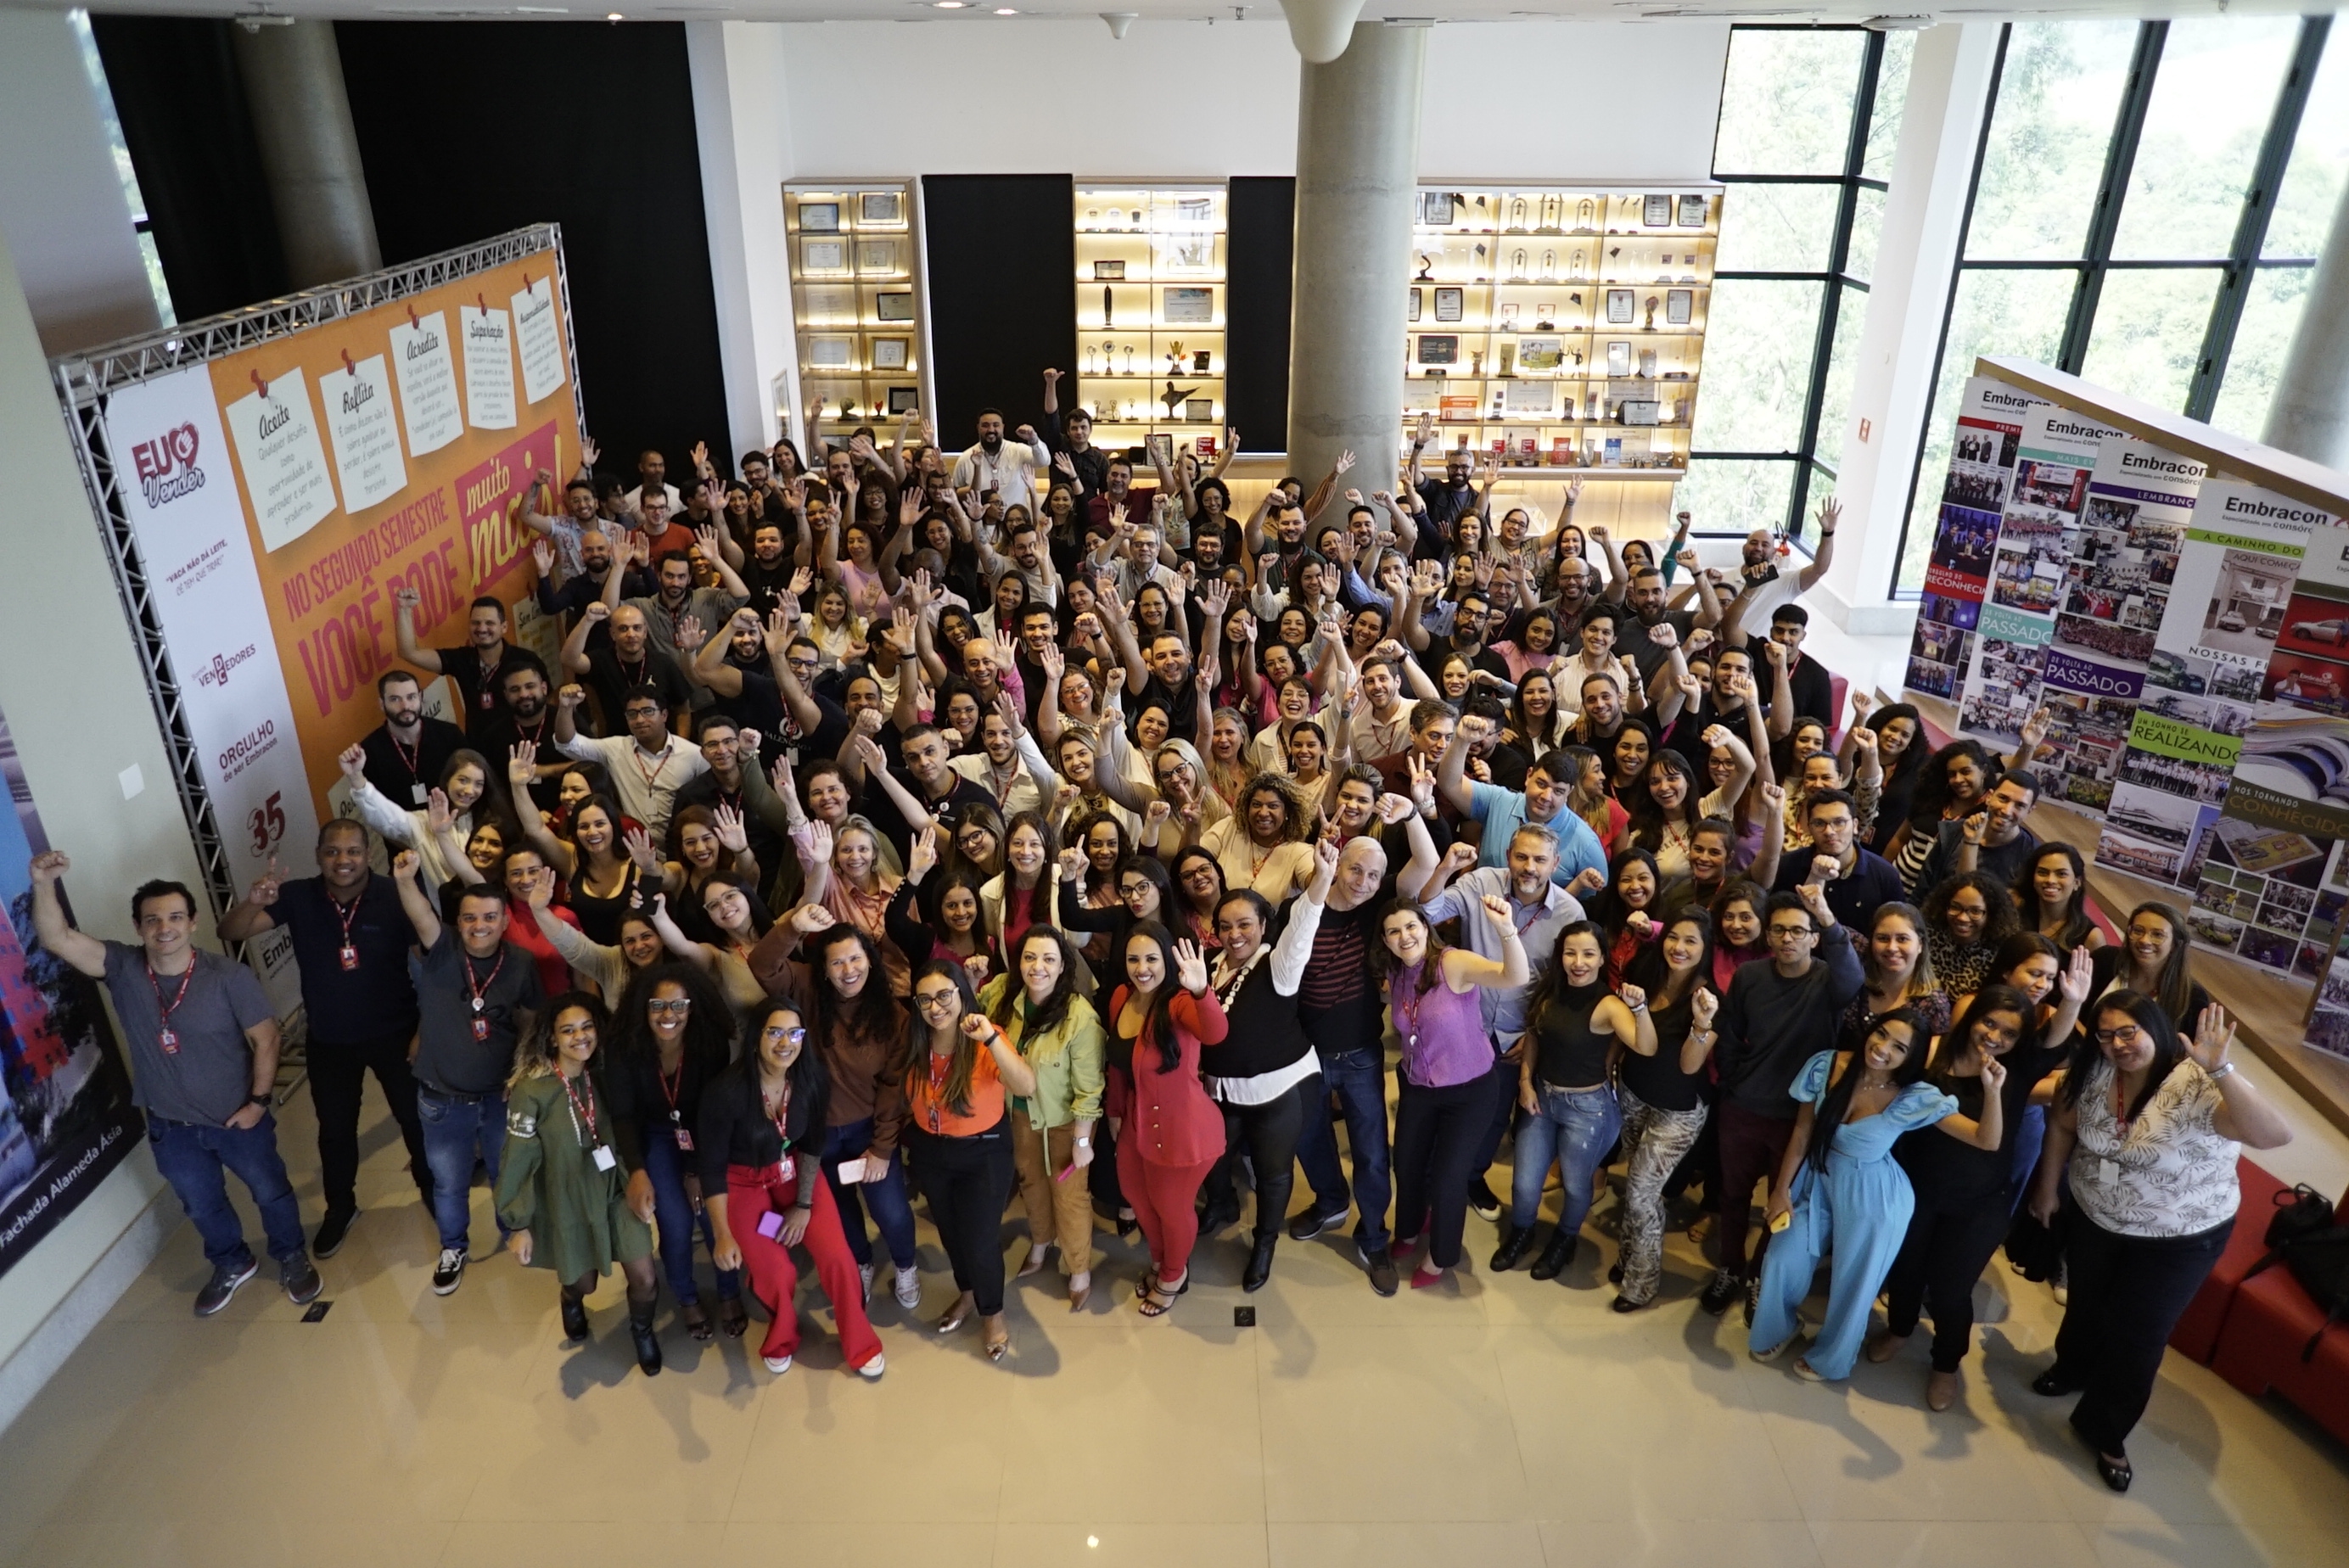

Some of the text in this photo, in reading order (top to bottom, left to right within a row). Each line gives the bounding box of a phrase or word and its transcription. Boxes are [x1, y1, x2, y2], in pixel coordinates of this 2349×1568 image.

[406, 332, 440, 361] Acredite
[343, 382, 374, 414] Reflita
[260, 405, 290, 440] Aceite
[1995, 423, 2021, 434] PREMI
[132, 435, 172, 484] EU
[143, 459, 205, 508] Vender
[467, 457, 510, 518] muito
[2137, 490, 2195, 508] LEMBRANÇ
[2225, 496, 2328, 525] Embracon
[283, 486, 449, 622] NO SEGUNDO SEMESTRE
[2217, 535, 2276, 552] CAMINHO
[2282, 546, 2301, 556] DO
[2233, 552, 2257, 564] AQUI
[187, 558, 199, 571] NÃO
[298, 536, 465, 718] VOCÊ PODE
[1994, 609, 2012, 620] VOLTA
[2062, 658, 2081, 669] VOLTA
[2083, 663, 2093, 671] AO
[2189, 647, 2247, 665] NOSSAS
[2046, 664, 2132, 696] PASSADO
[2150, 720, 2178, 732] SONHO
[219, 720, 274, 770] ORGULHO
[223, 736, 278, 782] de ser Embracon
[2234, 786, 2299, 808] NOS TORNANDO
[247, 790, 285, 858] 35
[0, 1195, 50, 1251] Fachada
[50, 1146, 99, 1200] Alameda
